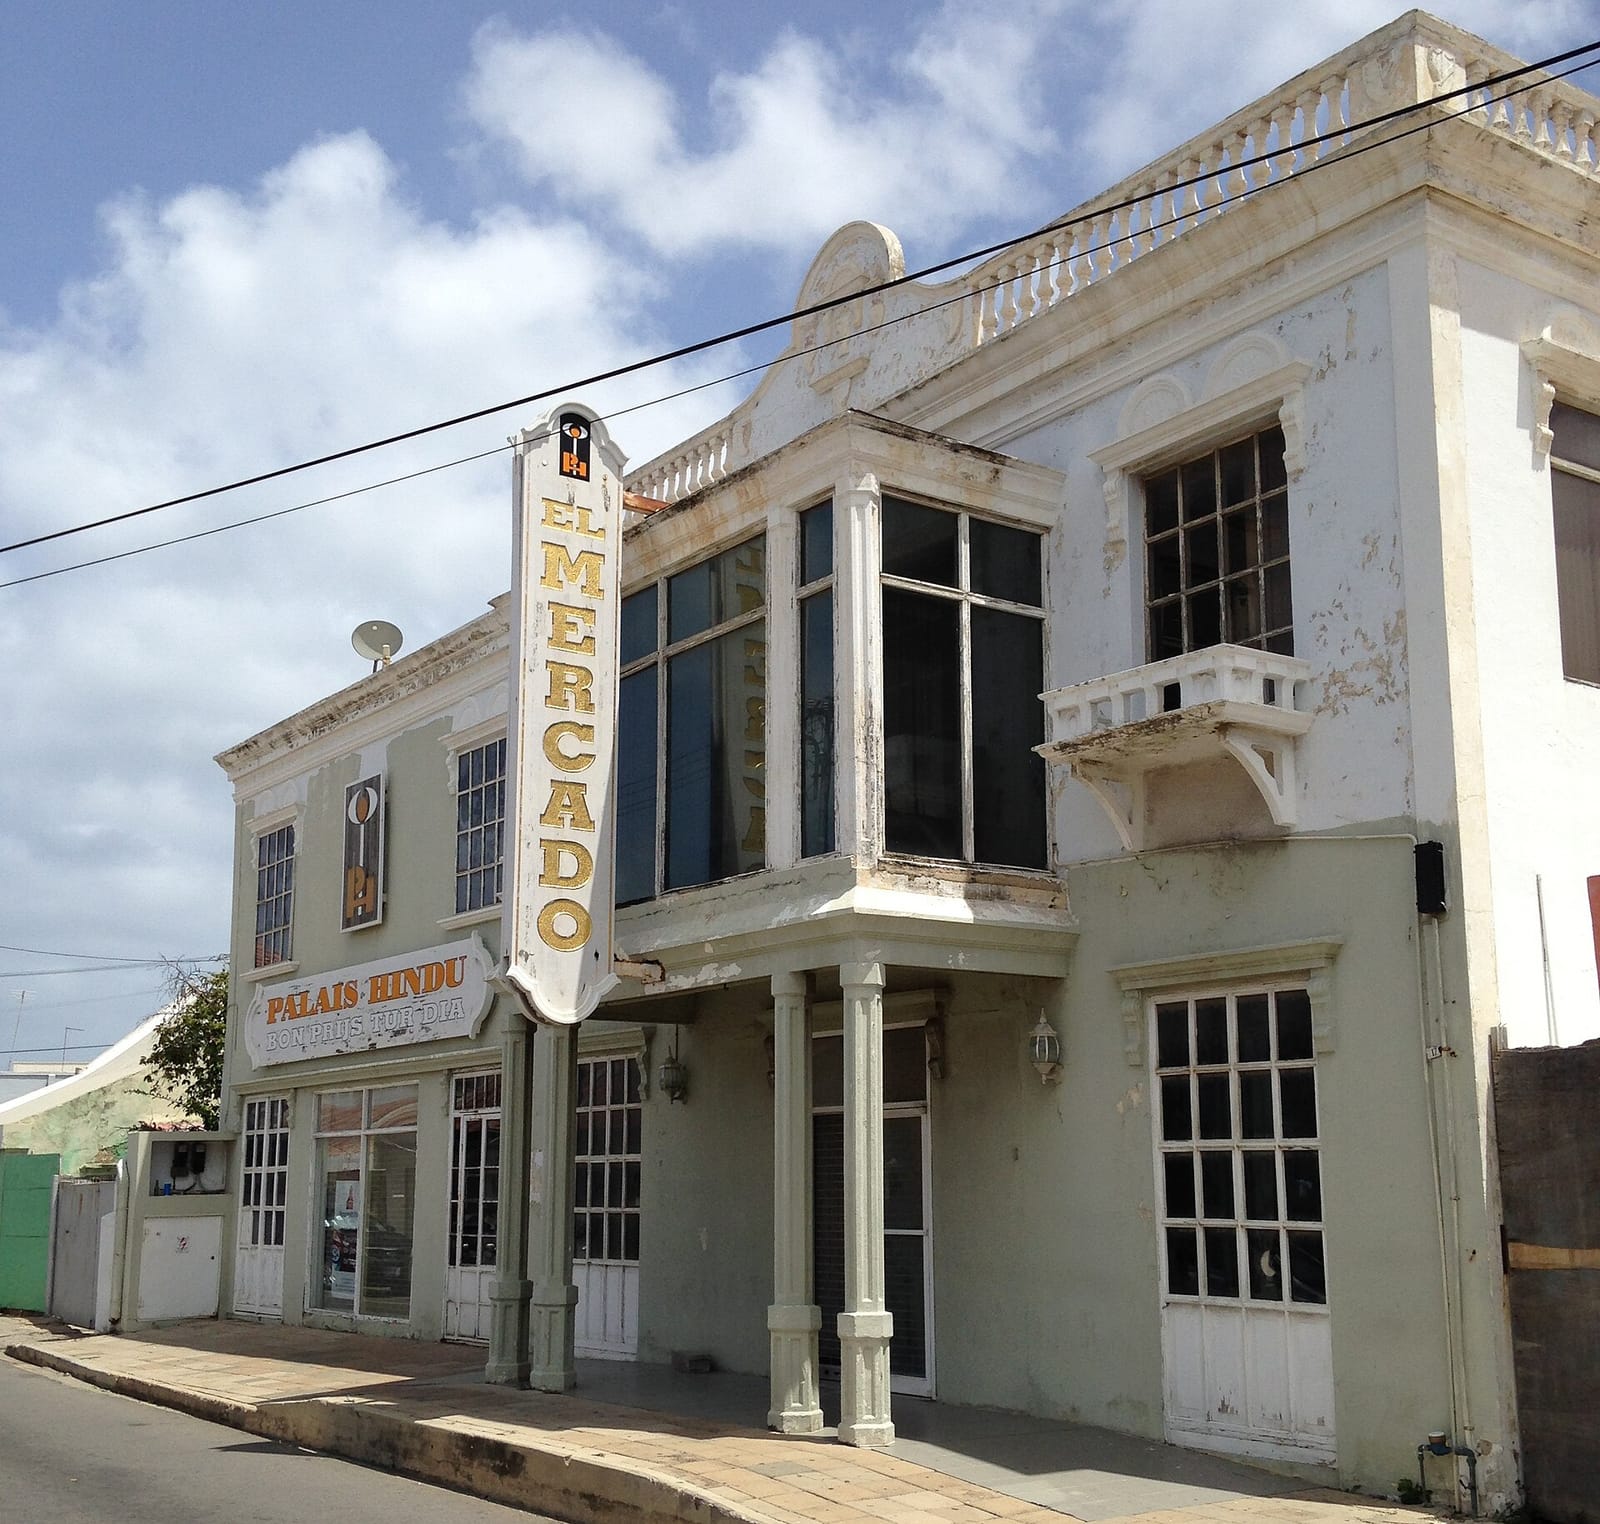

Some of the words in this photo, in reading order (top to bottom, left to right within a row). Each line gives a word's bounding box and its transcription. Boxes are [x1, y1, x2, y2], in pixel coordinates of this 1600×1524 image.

[541, 497, 606, 541] EL
[537, 540, 606, 952] MERCADO
[266, 979, 359, 1025] PALAIS
[367, 954, 467, 1004] HINDU
[265, 1026, 305, 1052] BON
[309, 1015, 364, 1044] PRIJS
[370, 1005, 414, 1034] TUR
[421, 997, 465, 1025] DIA
